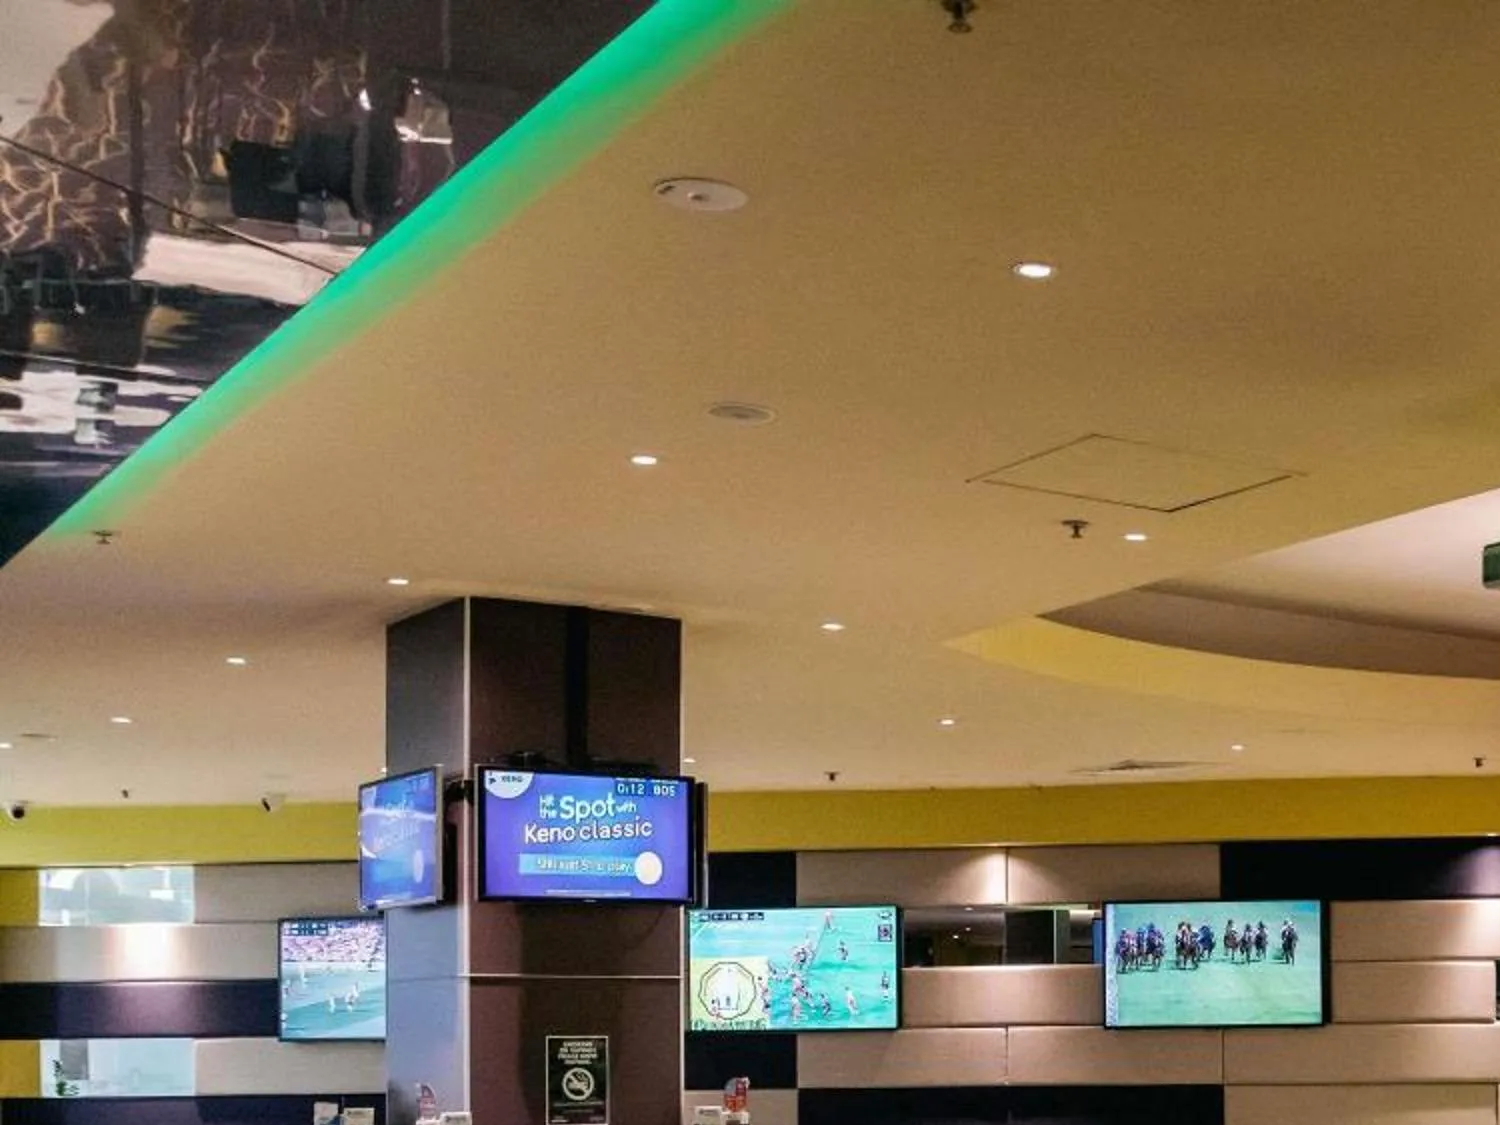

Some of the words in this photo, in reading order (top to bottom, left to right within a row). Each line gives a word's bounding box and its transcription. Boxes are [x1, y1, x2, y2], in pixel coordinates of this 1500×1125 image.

[559, 792, 616, 824] Spot
[524, 822, 575, 844] Keno
[580, 815, 653, 840] classic
